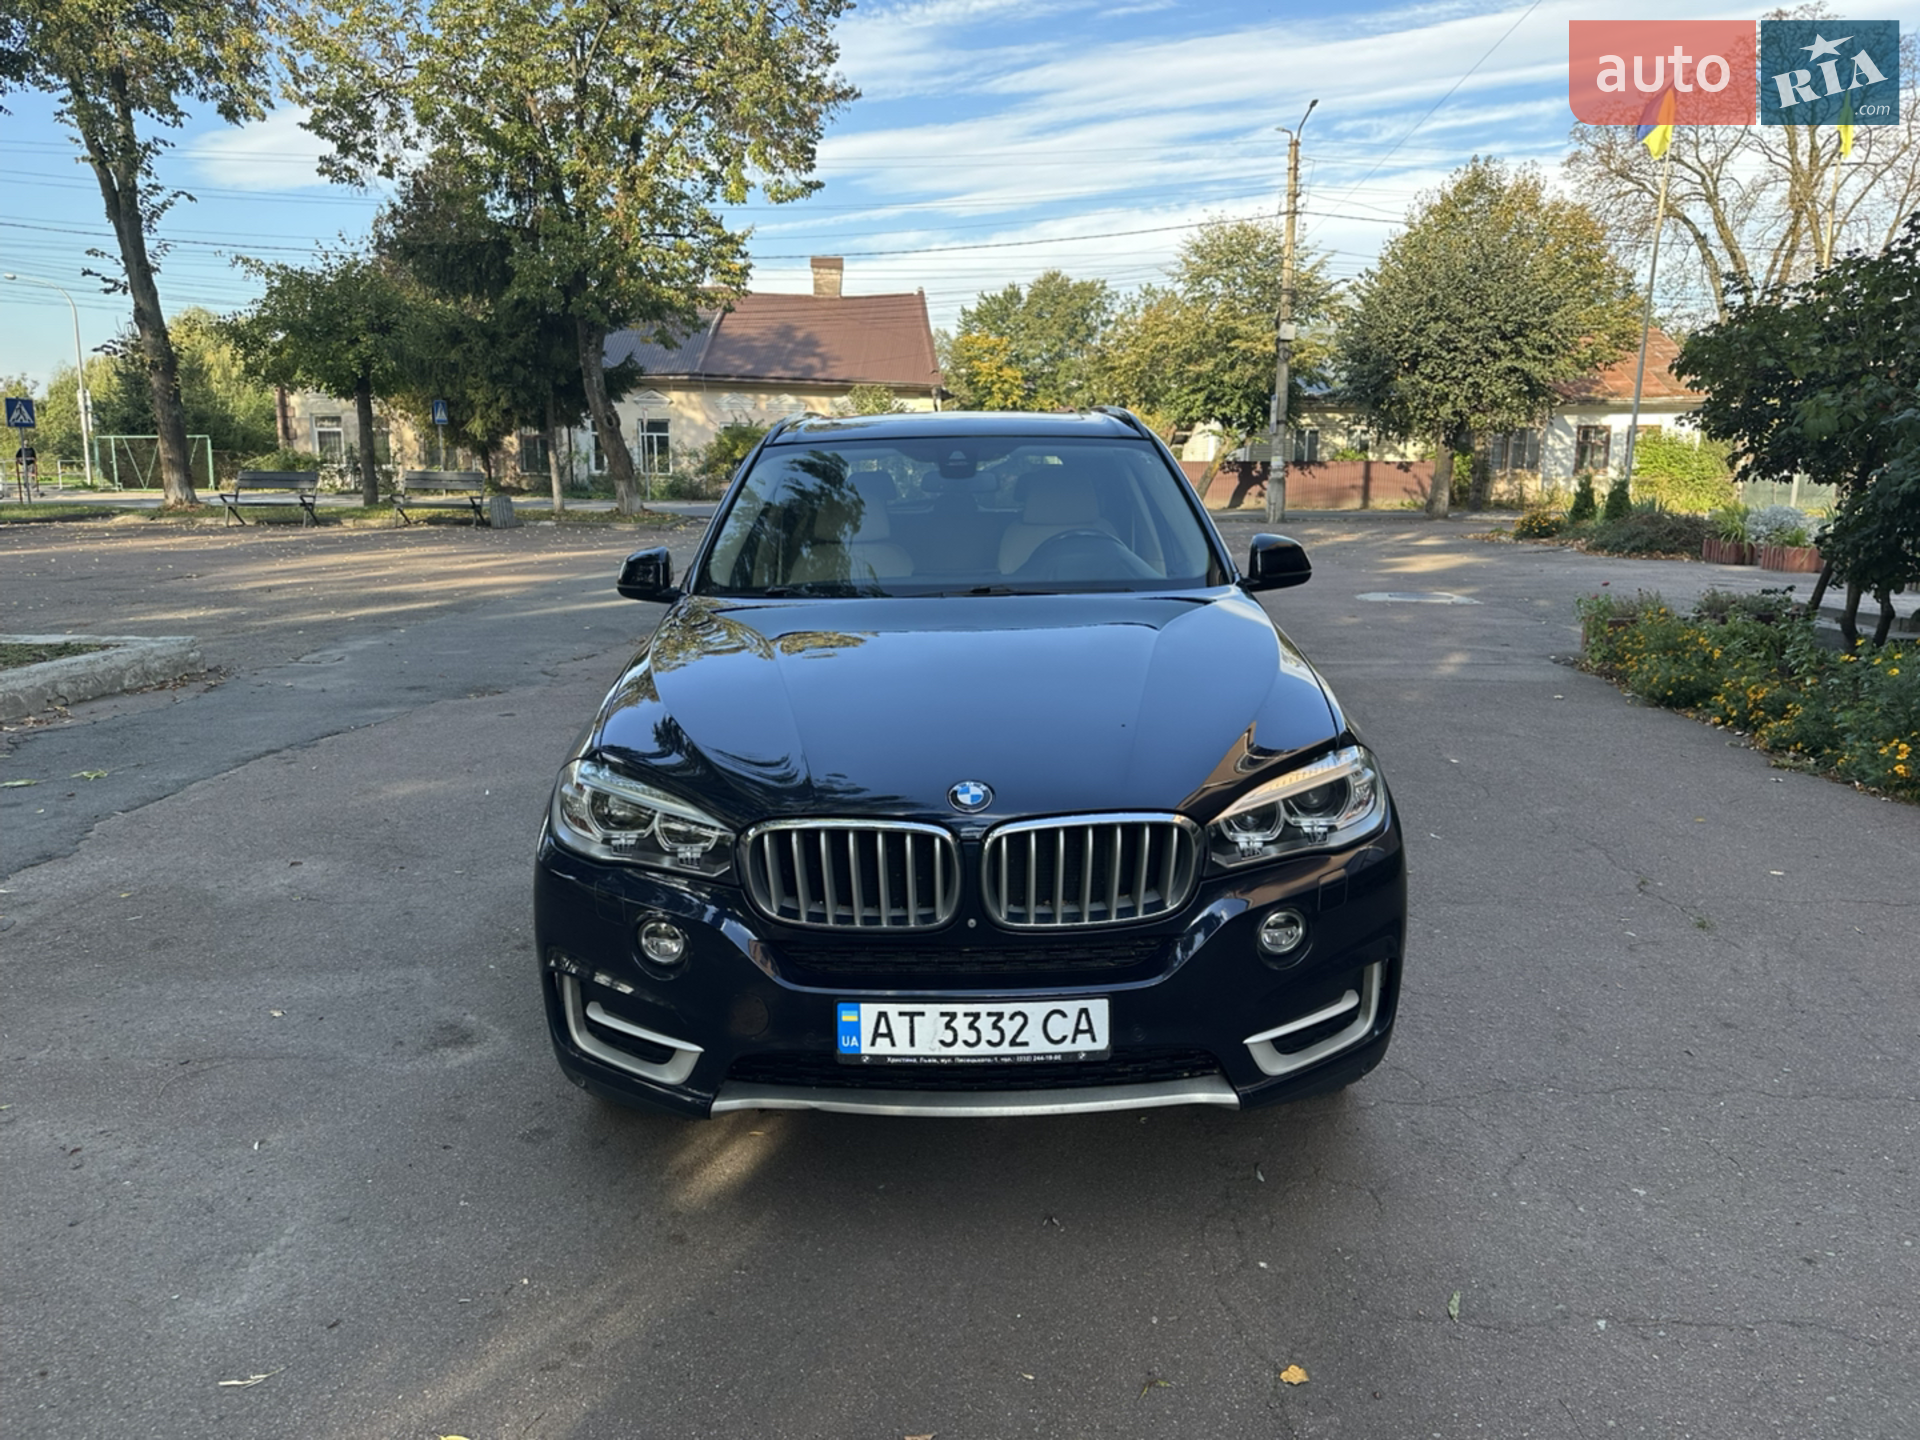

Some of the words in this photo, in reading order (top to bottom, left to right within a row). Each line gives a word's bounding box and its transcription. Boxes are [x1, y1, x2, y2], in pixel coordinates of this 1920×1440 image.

[870, 1011, 925, 1048] AT
[938, 1010, 1030, 1048] 3332
[1042, 1007, 1097, 1045] CA
[842, 1035, 859, 1047] UA
